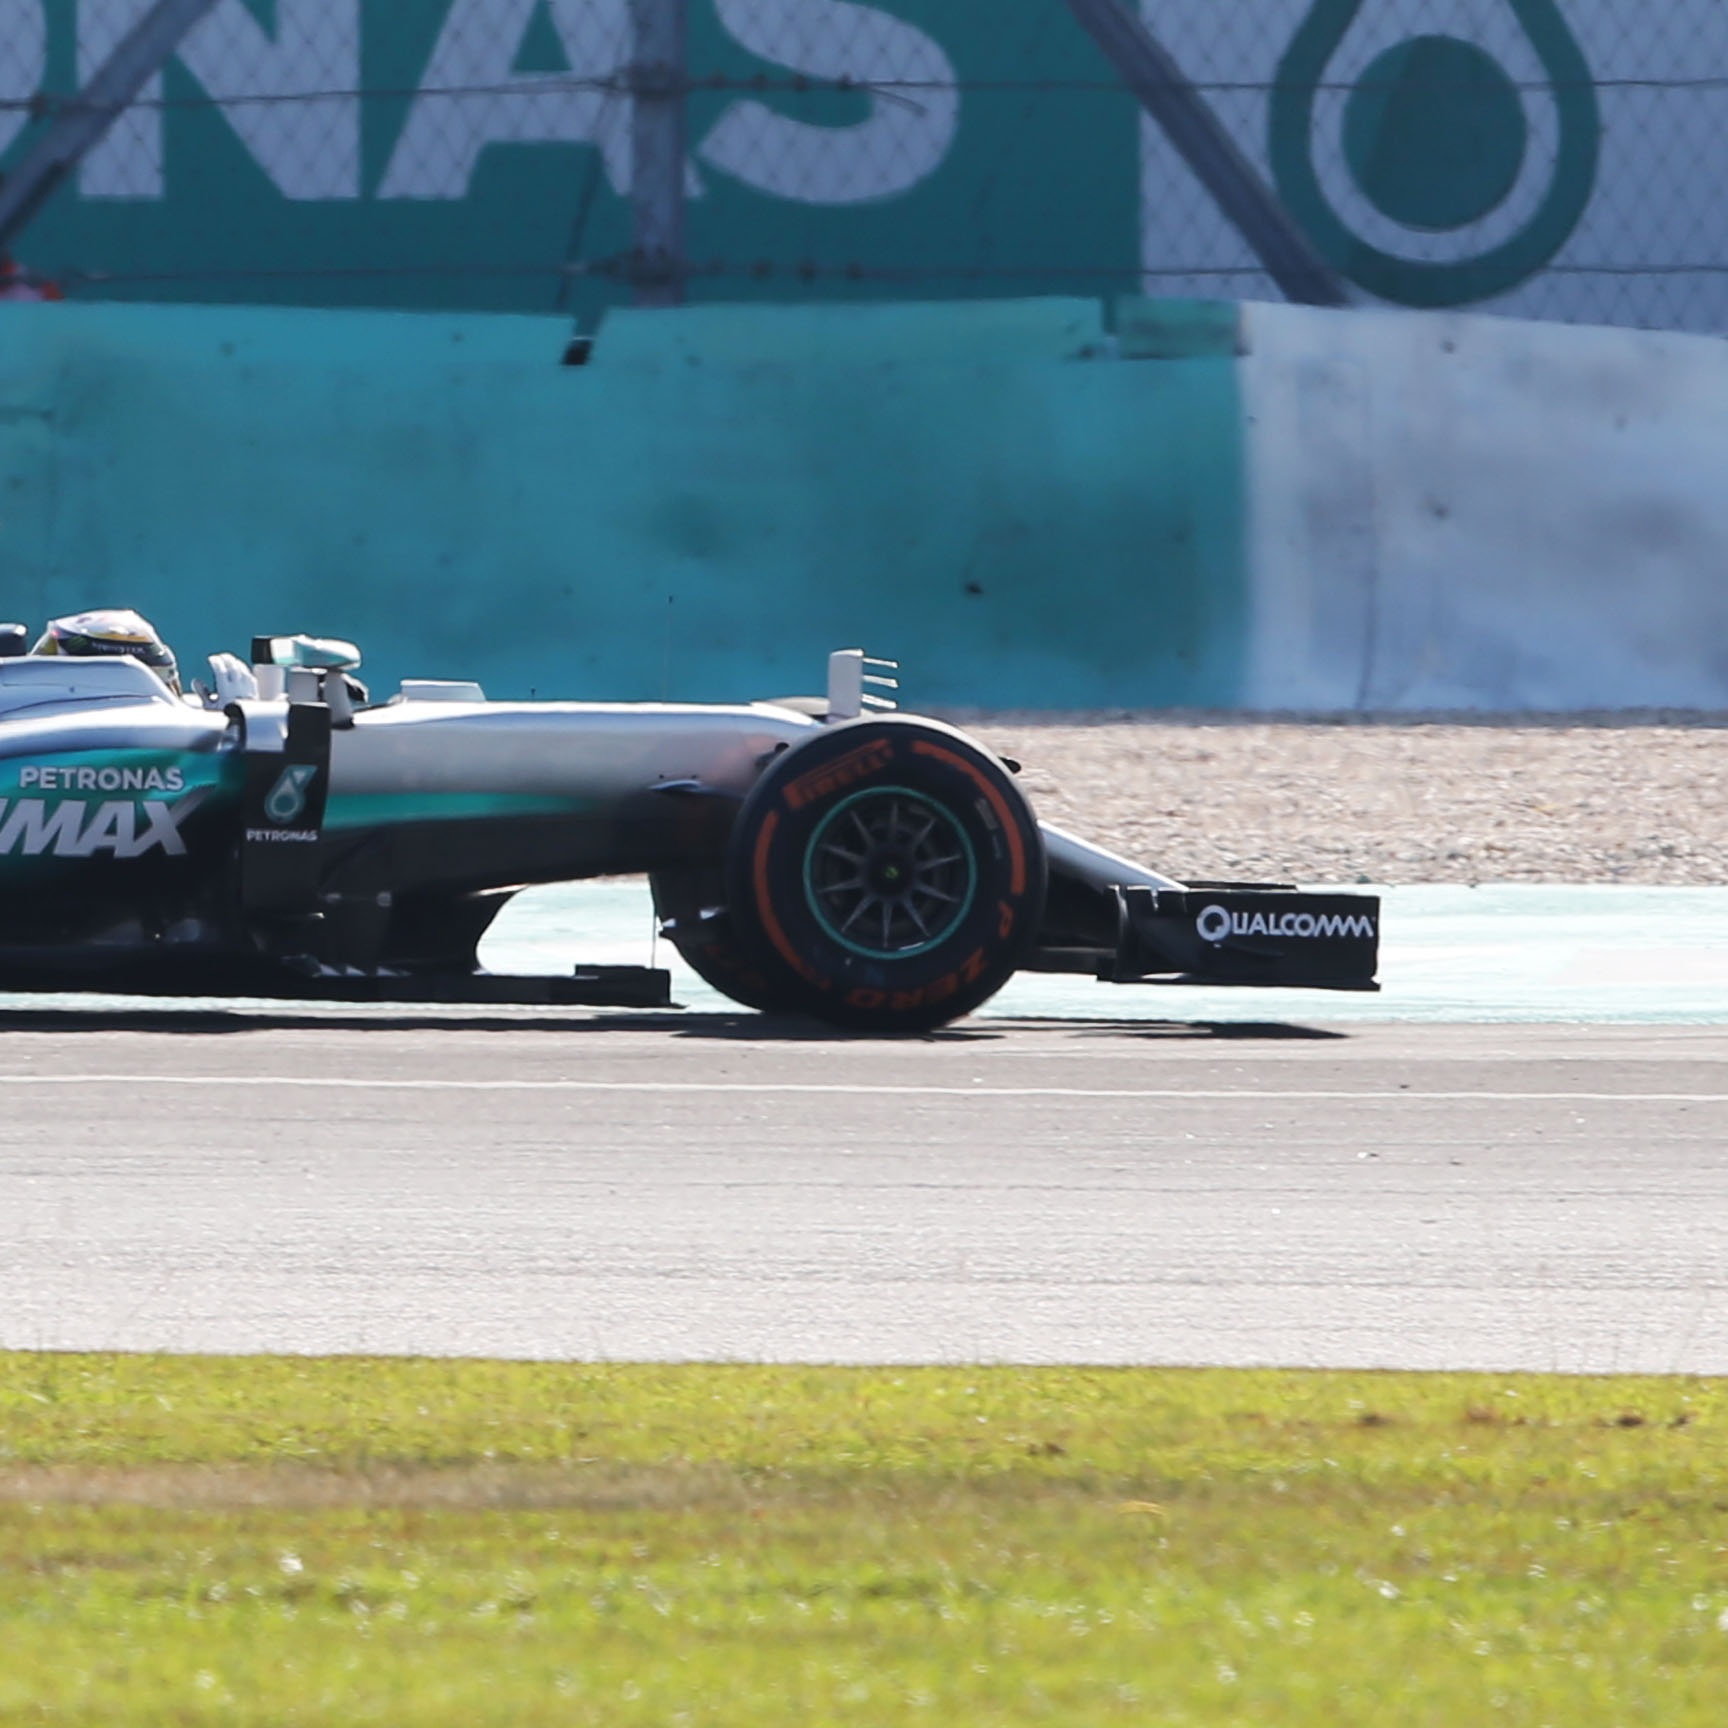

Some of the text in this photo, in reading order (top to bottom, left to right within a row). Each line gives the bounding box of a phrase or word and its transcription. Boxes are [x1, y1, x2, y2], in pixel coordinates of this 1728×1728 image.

[19, 764, 185, 792] PETRONAS
[246, 829, 319, 842] PETRONAS
[1195, 904, 1375, 942] QUALCOMM
